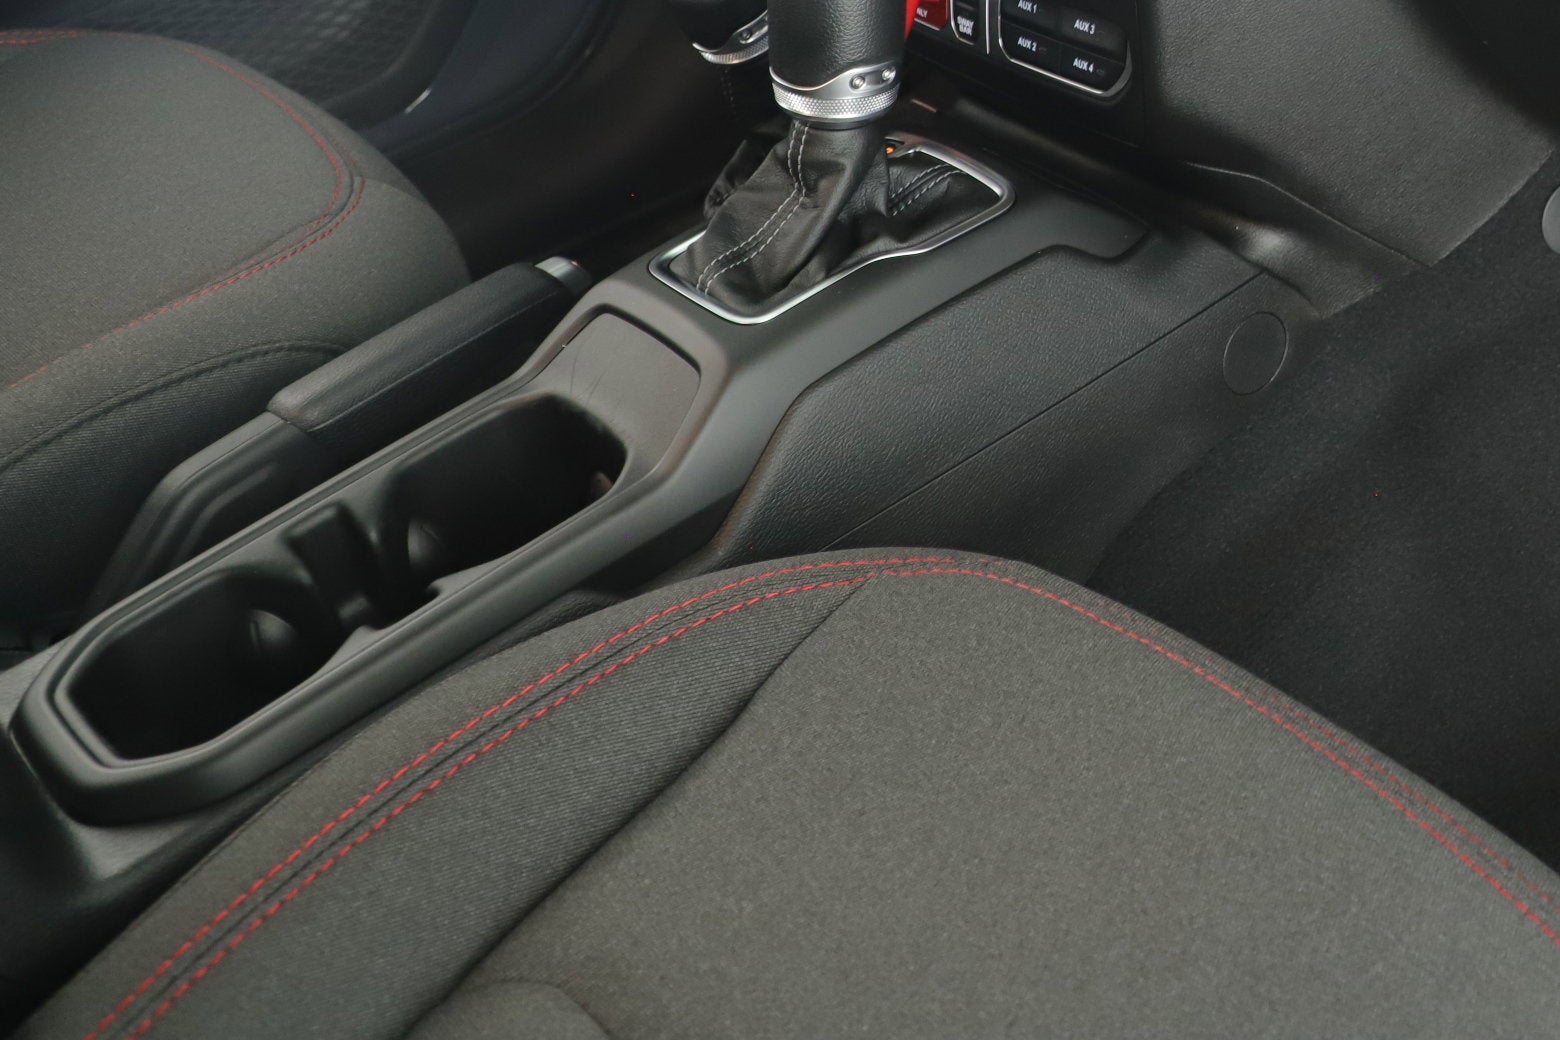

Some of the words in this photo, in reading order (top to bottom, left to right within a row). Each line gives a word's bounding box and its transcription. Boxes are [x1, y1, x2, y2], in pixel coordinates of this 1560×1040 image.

[1033, 4, 1037, 14] 1
[1073, 18, 1089, 33] AUX
[1089, 24, 1095, 35] 3
[1017, 37, 1031, 50] AUX
[1031, 42, 1037, 52] 2
[1073, 57, 1088, 71] AUX
[1088, 63, 1094, 73] 4
